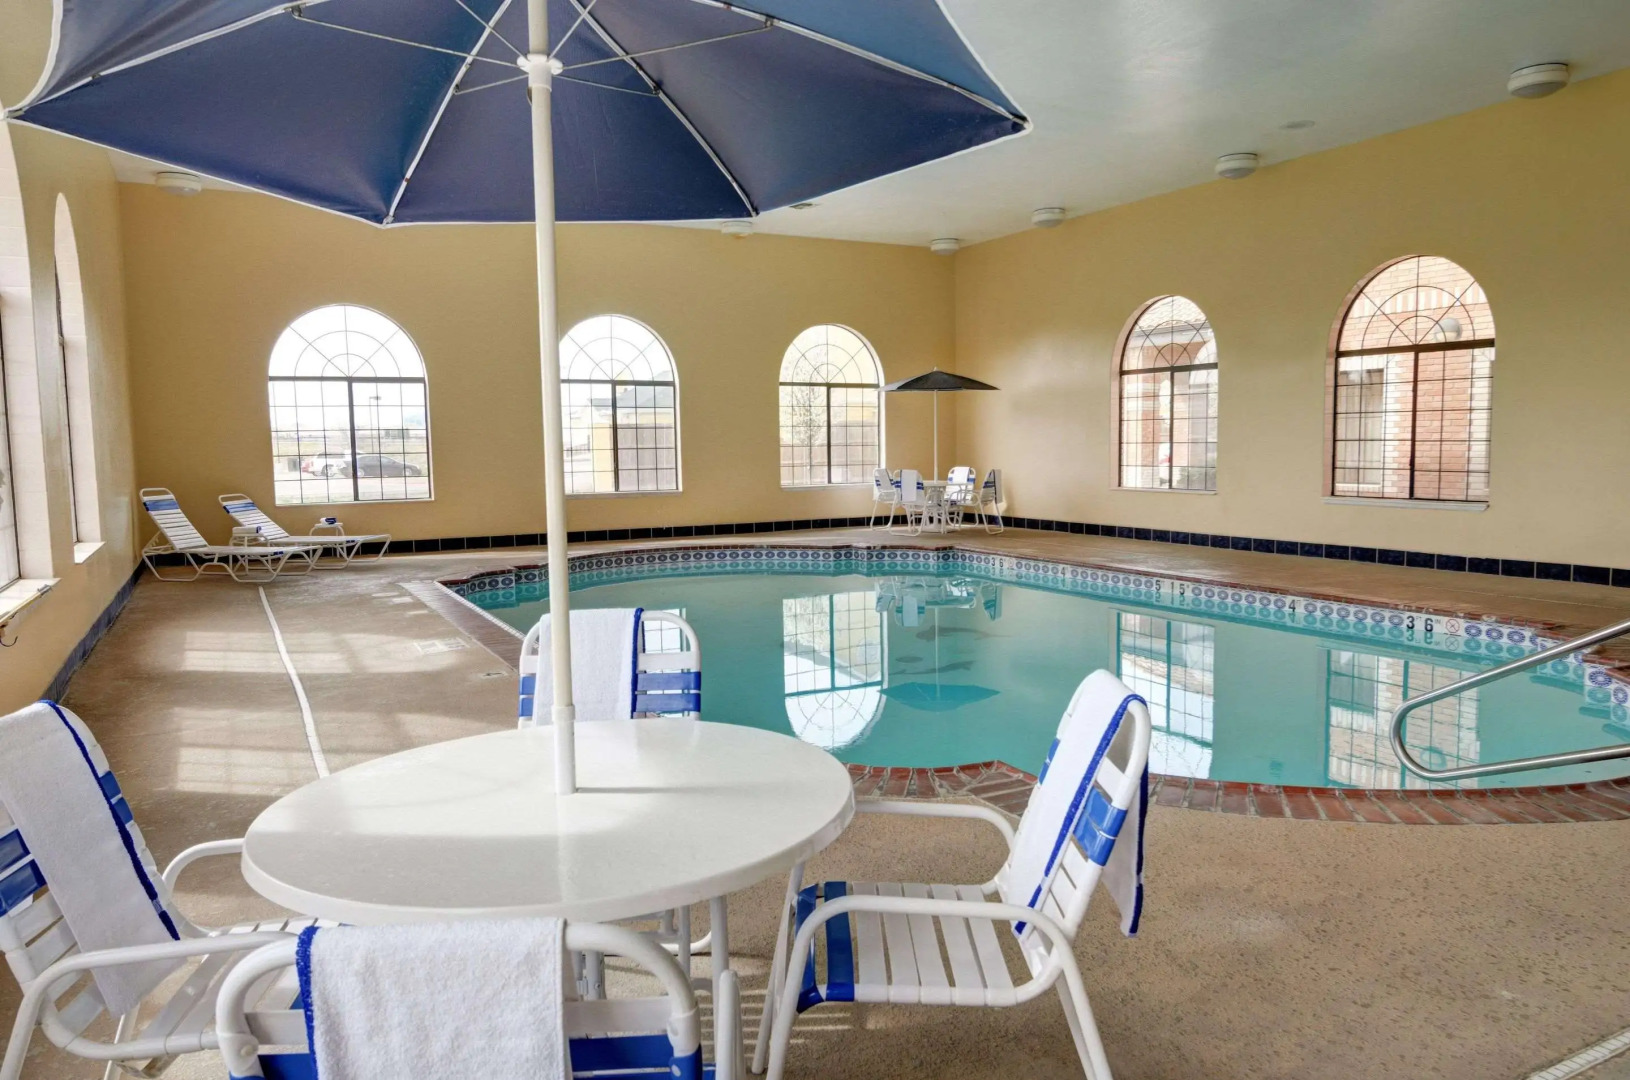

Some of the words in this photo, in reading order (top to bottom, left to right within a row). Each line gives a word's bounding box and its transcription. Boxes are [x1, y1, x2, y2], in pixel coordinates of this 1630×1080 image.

[1060, 566, 1066, 577] 4
[1155, 580, 1161, 591] 5
[1288, 599, 1296, 612] 4
[1406, 615, 1415, 629] 3
[1424, 617, 1434, 632] 6
